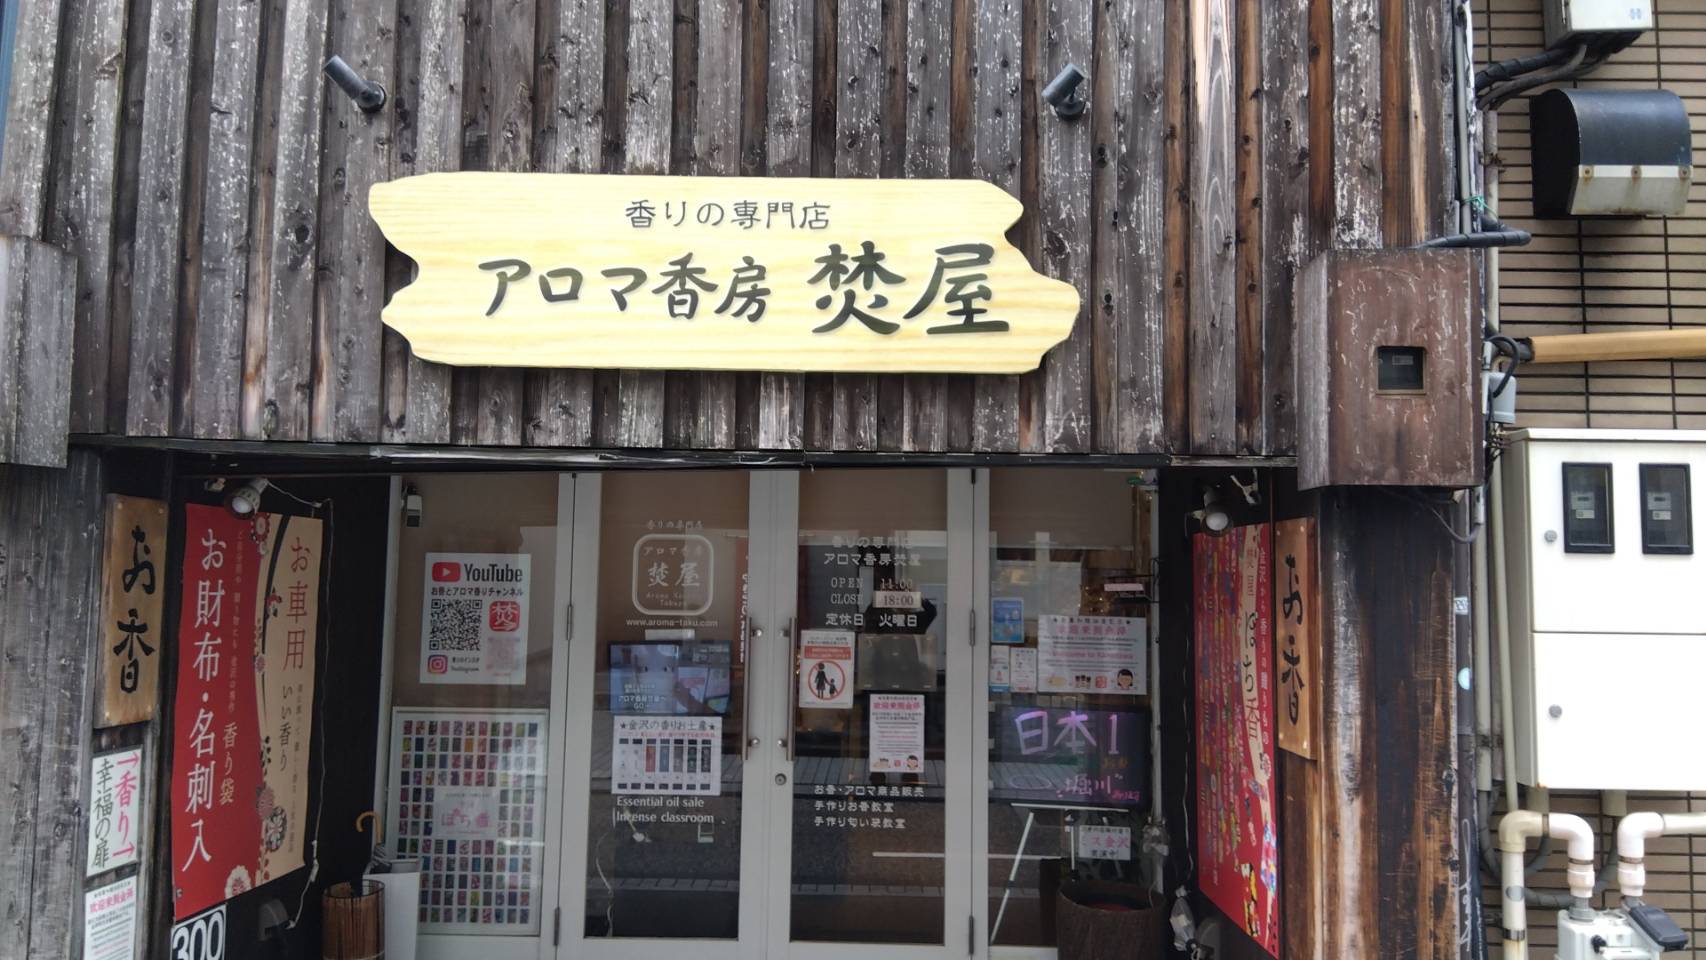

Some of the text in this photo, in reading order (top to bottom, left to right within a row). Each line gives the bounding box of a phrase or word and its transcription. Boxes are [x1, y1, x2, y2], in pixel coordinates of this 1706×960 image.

[624, 199, 832, 231] 香りの専門店
[478, 240, 1010, 336] アロマ香房 焚屋
[464, 563, 523, 582] YouTube
[648, 561, 700, 587] 焚屋
[830, 577, 864, 588] OPEN
[112, 525, 155, 694] お香
[283, 536, 311, 670] お車用
[830, 593, 914, 606] CLOSE 18:00
[625, 618, 718, 628] www.aroma-taku.com
[825, 613, 918, 627] 定休日 火曜日
[182, 528, 228, 872] お財布・名刺入
[219, 721, 240, 806] 香り袋
[616, 795, 705, 808] Essential oil sale
[814, 785, 924, 798] お香・アロマ商品販売
[93, 758, 115, 868] 幸福の扉
[115, 770, 137, 844] 香り
[660, 811, 714, 824] classroom
[814, 800, 894, 812] 手作りお香教室
[172, 912, 223, 960] 300
